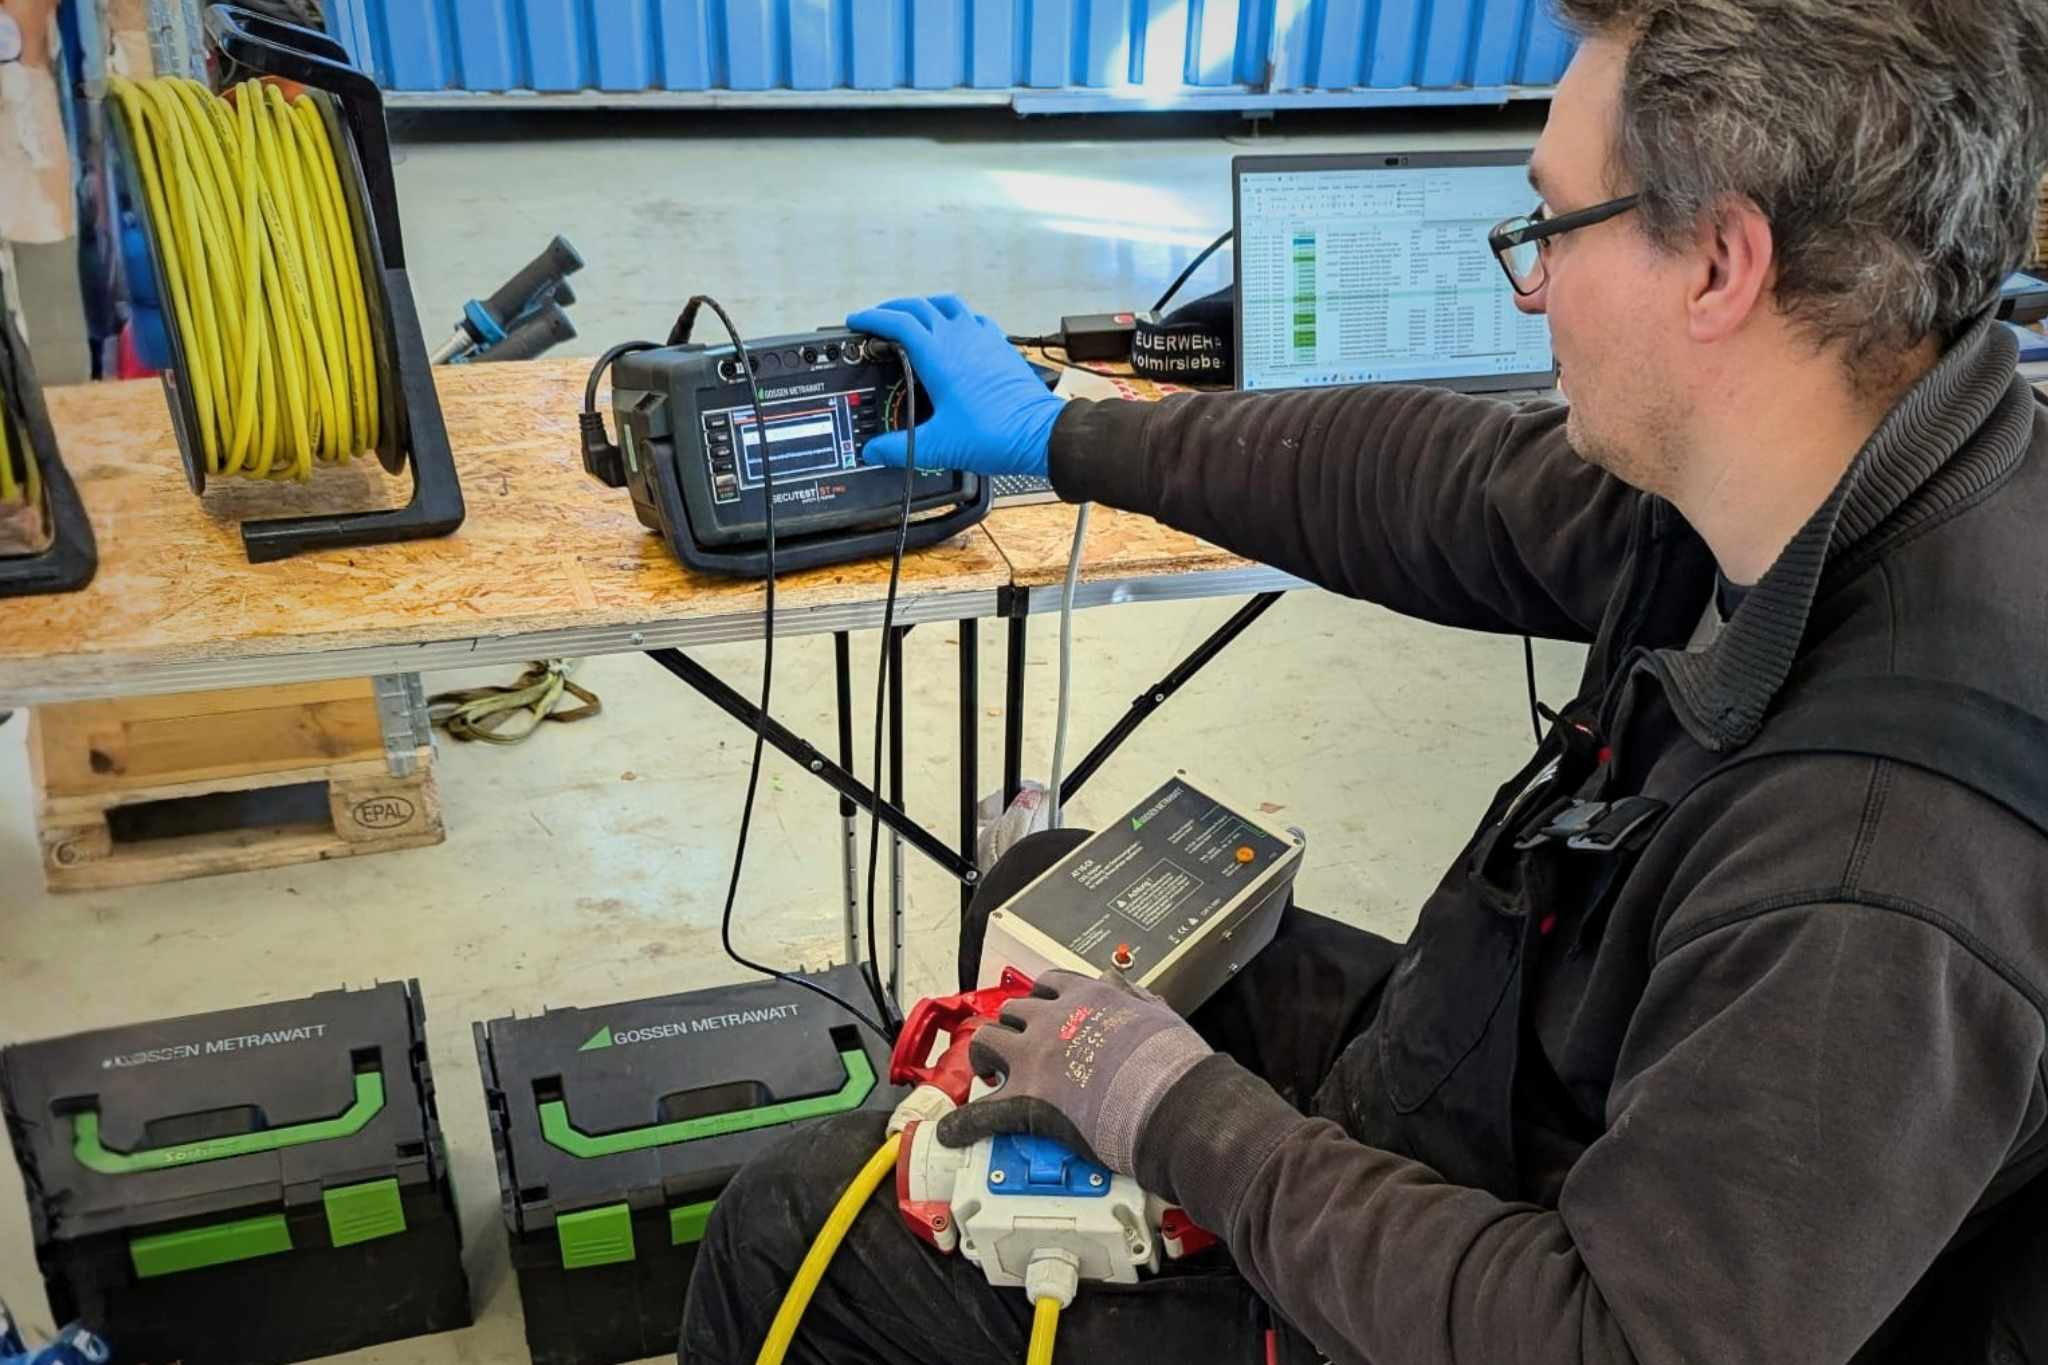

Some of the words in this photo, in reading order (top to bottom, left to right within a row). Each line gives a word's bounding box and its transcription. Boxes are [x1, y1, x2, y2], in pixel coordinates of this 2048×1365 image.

[362, 803, 408, 823] EPAL
[205, 1024, 327, 1053] METRAWATT
[614, 1021, 688, 1046] GOSSEN
[691, 1003, 800, 1033] METRAWATT
